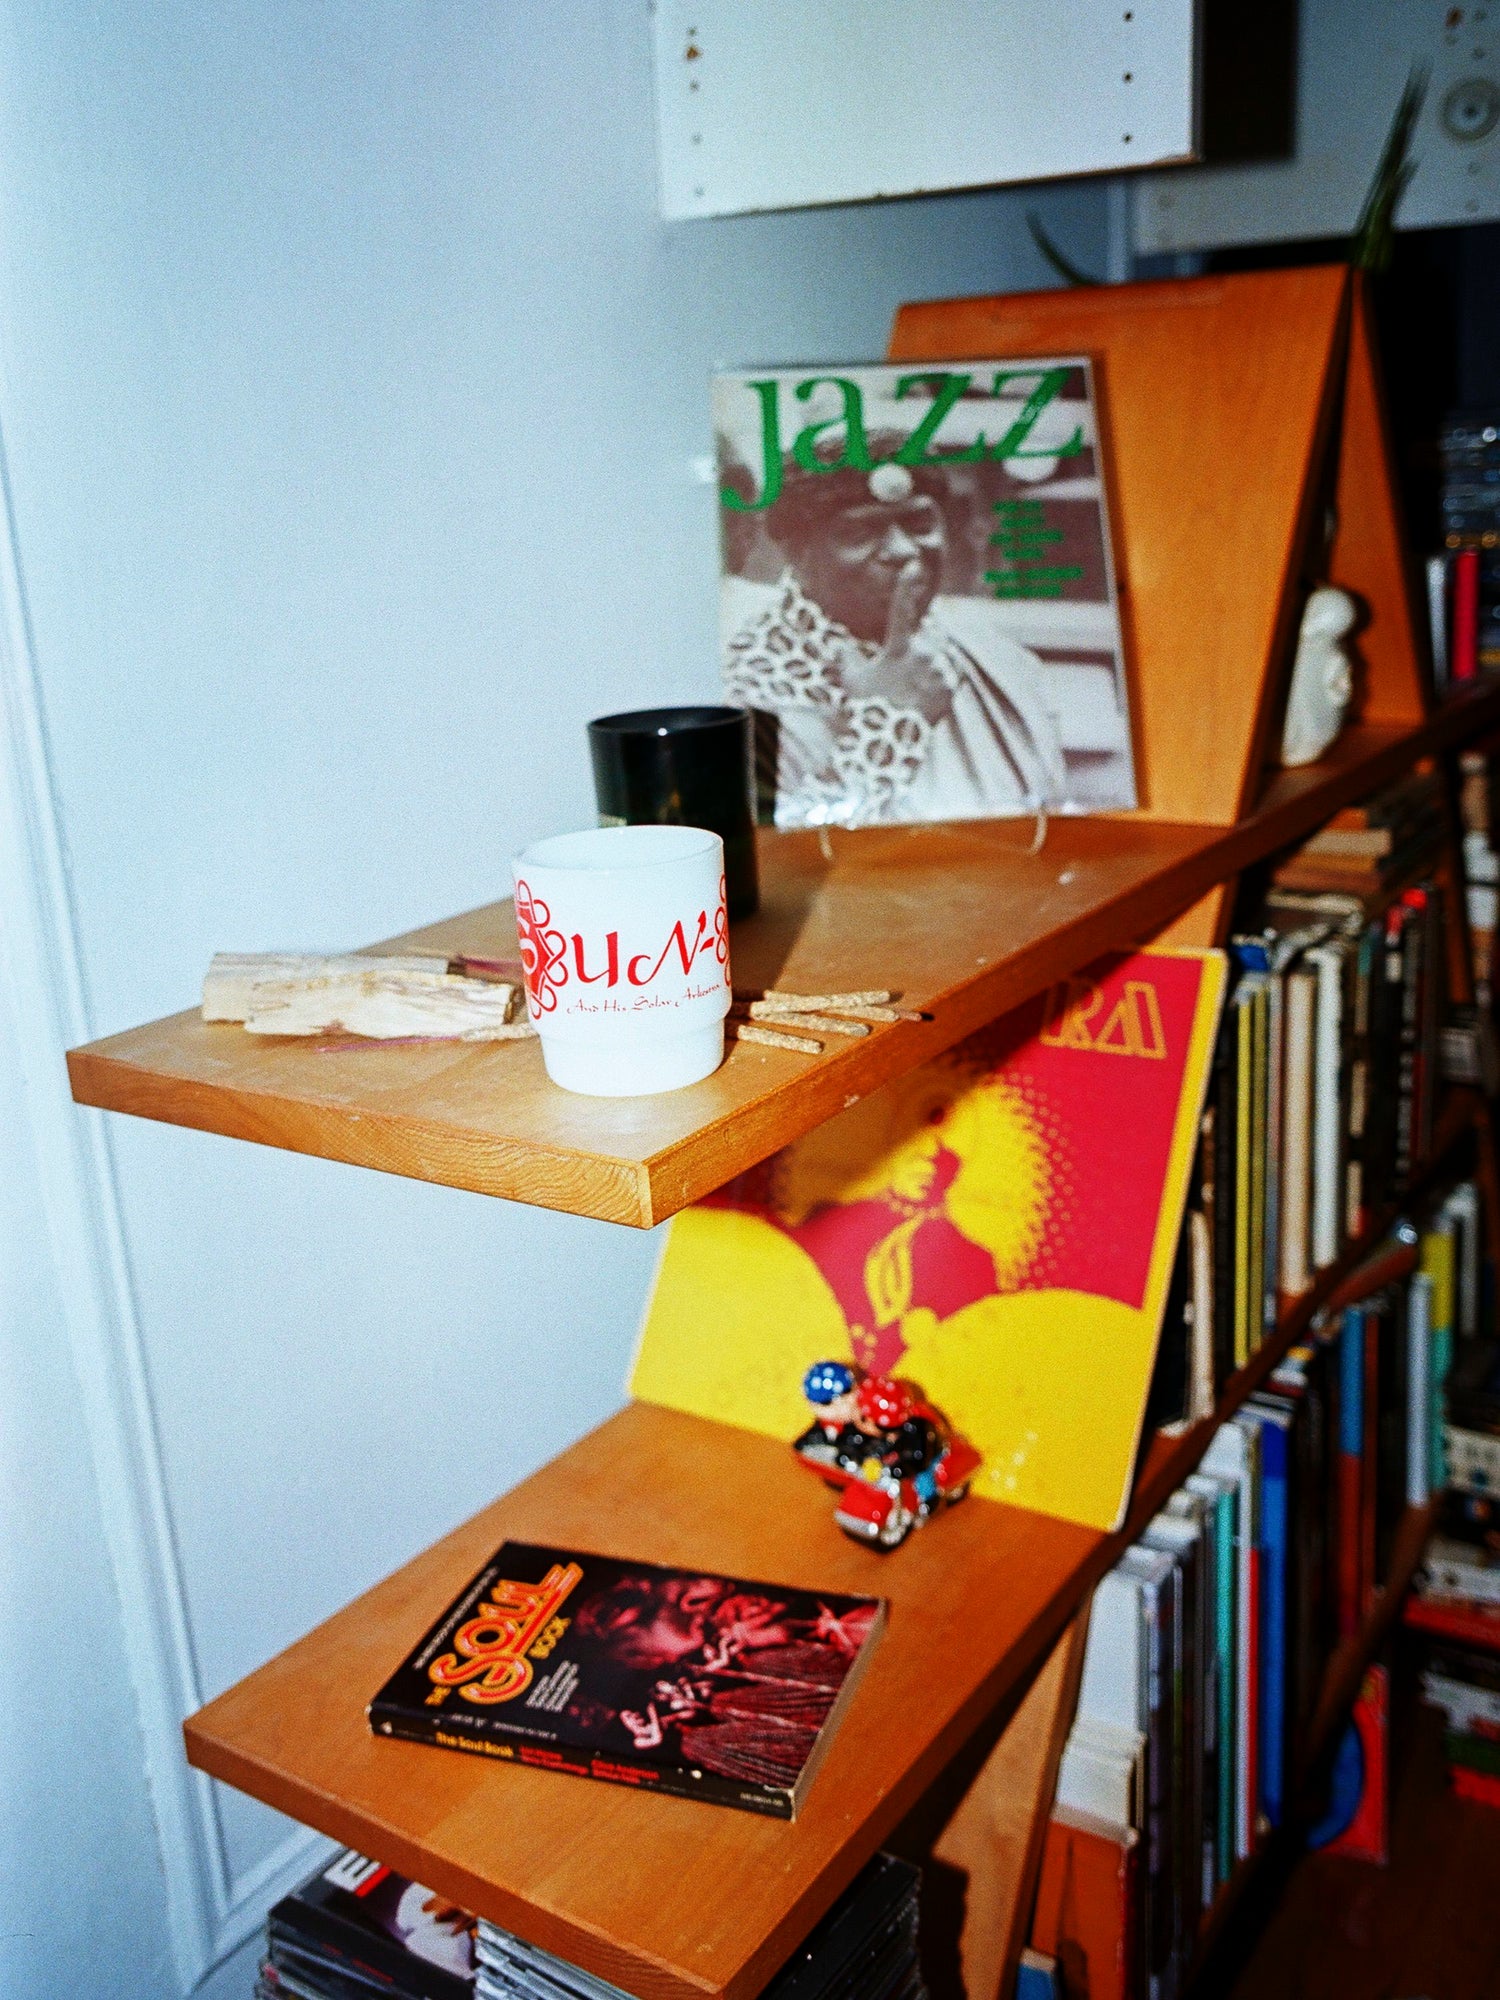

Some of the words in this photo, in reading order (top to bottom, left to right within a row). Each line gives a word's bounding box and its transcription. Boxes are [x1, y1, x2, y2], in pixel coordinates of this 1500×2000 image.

[720, 367, 1085, 513] jazz
[526, 1614, 573, 1660] BOOK
[458, 1735, 484, 1754] Soul
[483, 1740, 514, 1758] Book
